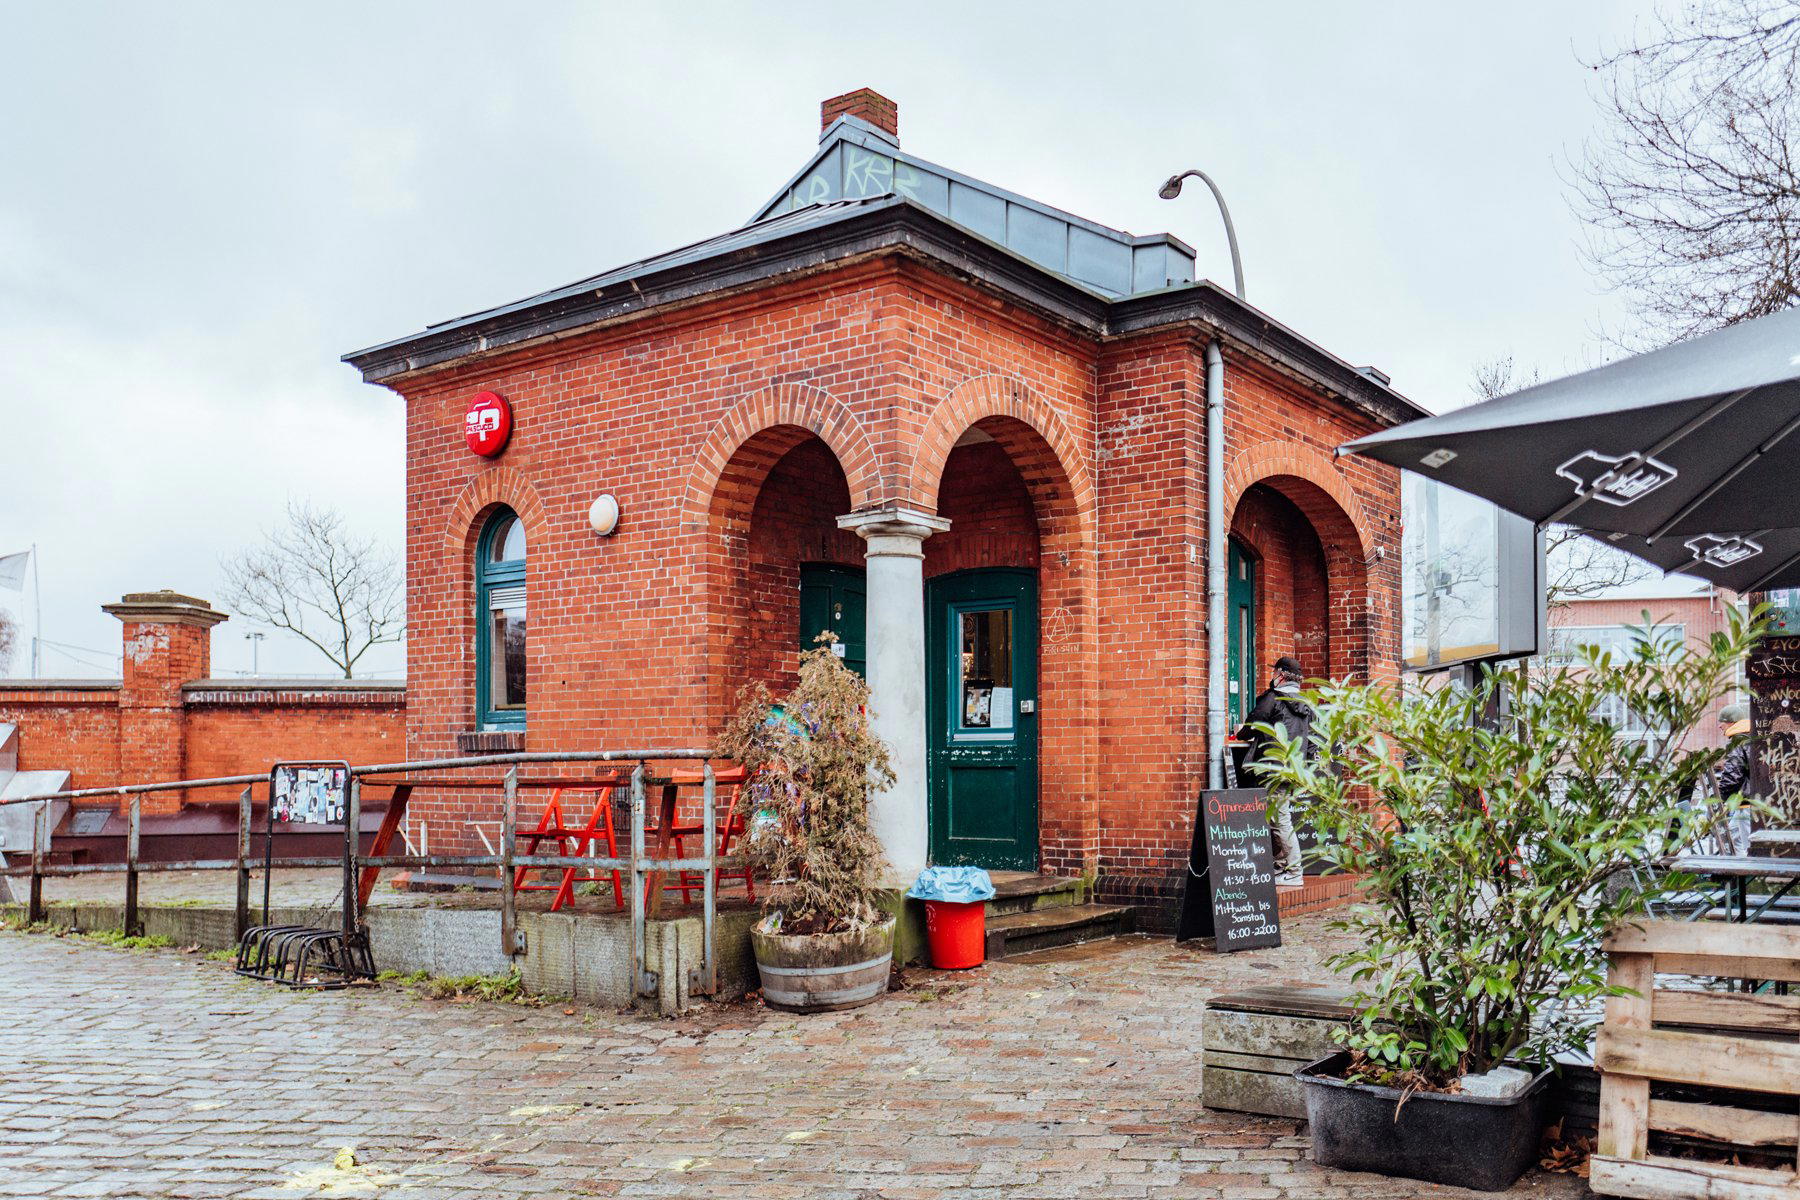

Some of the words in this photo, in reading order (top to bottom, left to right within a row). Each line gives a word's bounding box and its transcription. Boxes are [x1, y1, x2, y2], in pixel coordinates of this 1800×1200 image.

[1209, 823, 1269, 846] Mittagstisch
[1211, 843, 1248, 861] Montag
[1252, 842, 1266, 854] bis
[1227, 859, 1256, 876] Freitag
[1214, 888, 1248, 902] Abends
[1215, 901, 1255, 915] Mittwoch
[1258, 900, 1270, 911] bis
[1231, 912, 1266, 928] Samstag
